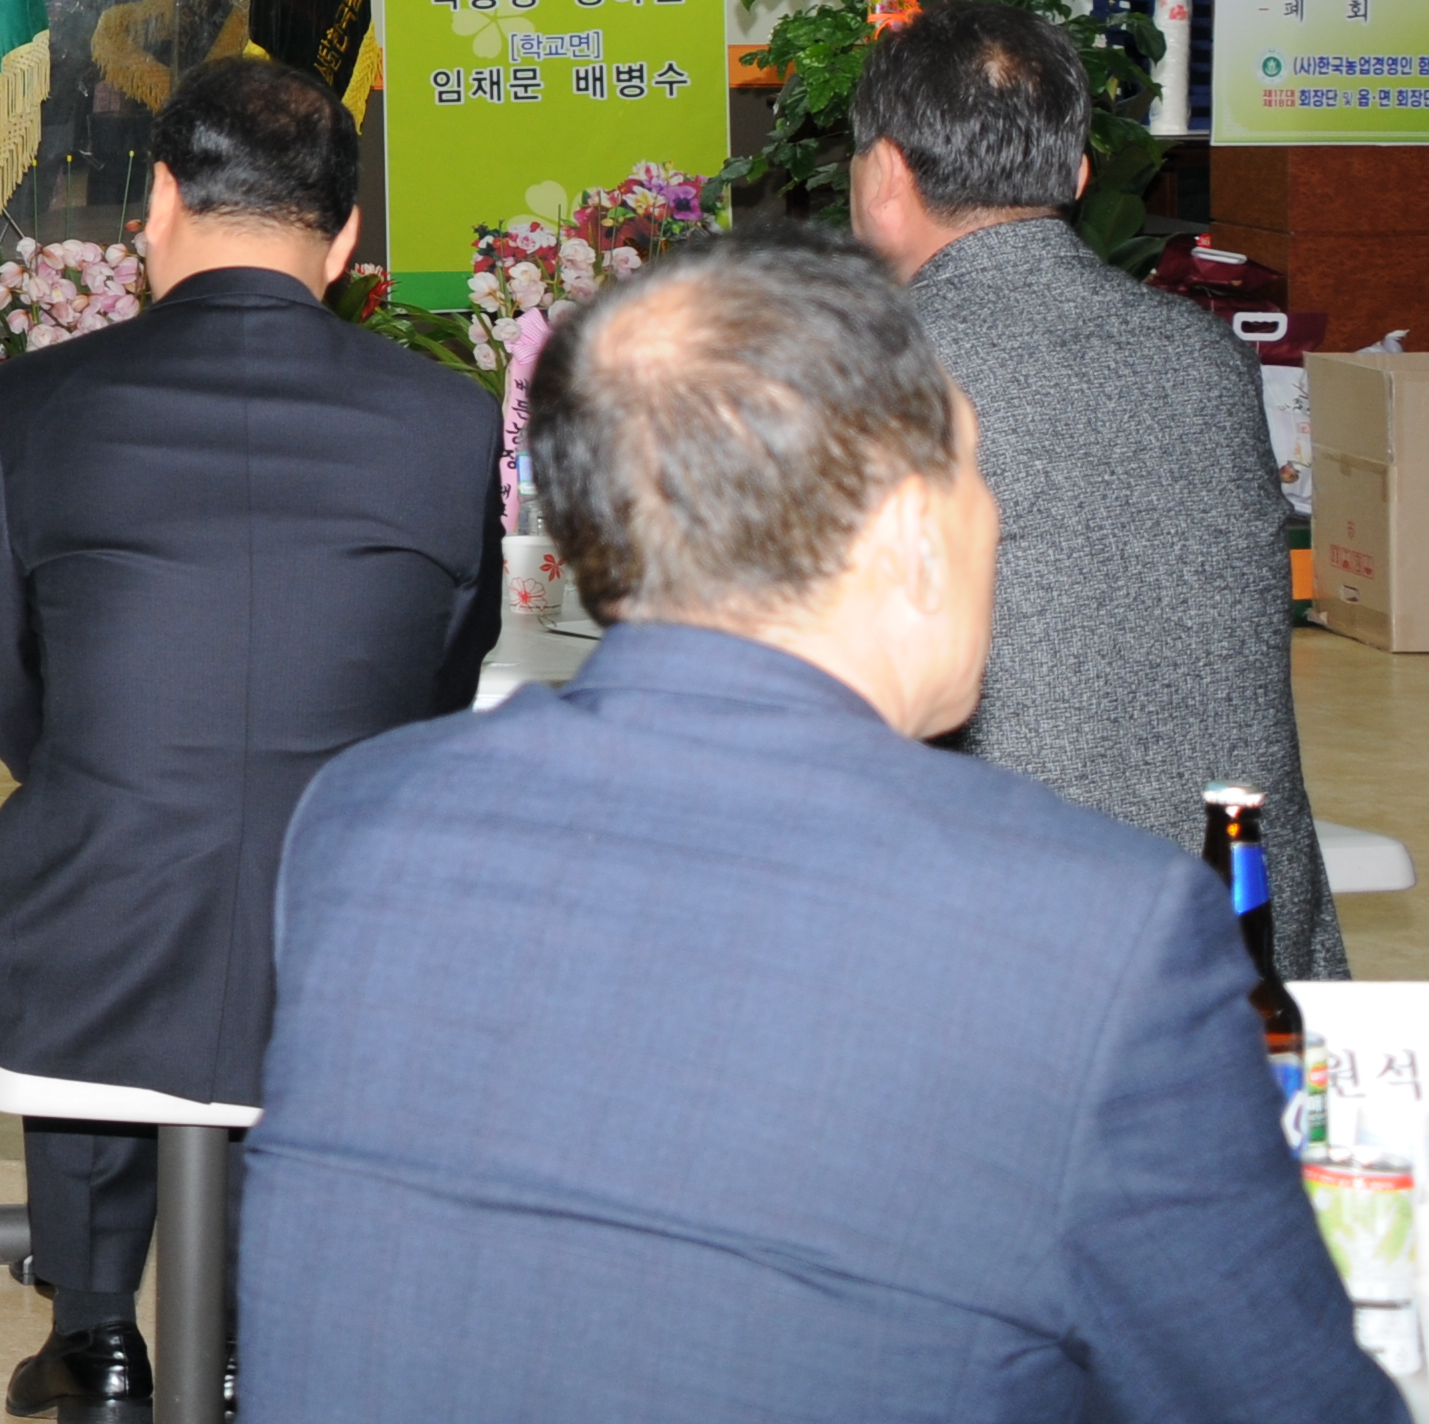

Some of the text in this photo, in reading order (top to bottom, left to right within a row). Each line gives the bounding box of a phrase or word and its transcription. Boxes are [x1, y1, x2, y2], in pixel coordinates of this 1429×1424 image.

[1293, 56, 1413, 76] (사)한국농업경영인
[431, 61, 690, 105] 임채문 배병수
[1299, 89, 1338, 108] 회장단
